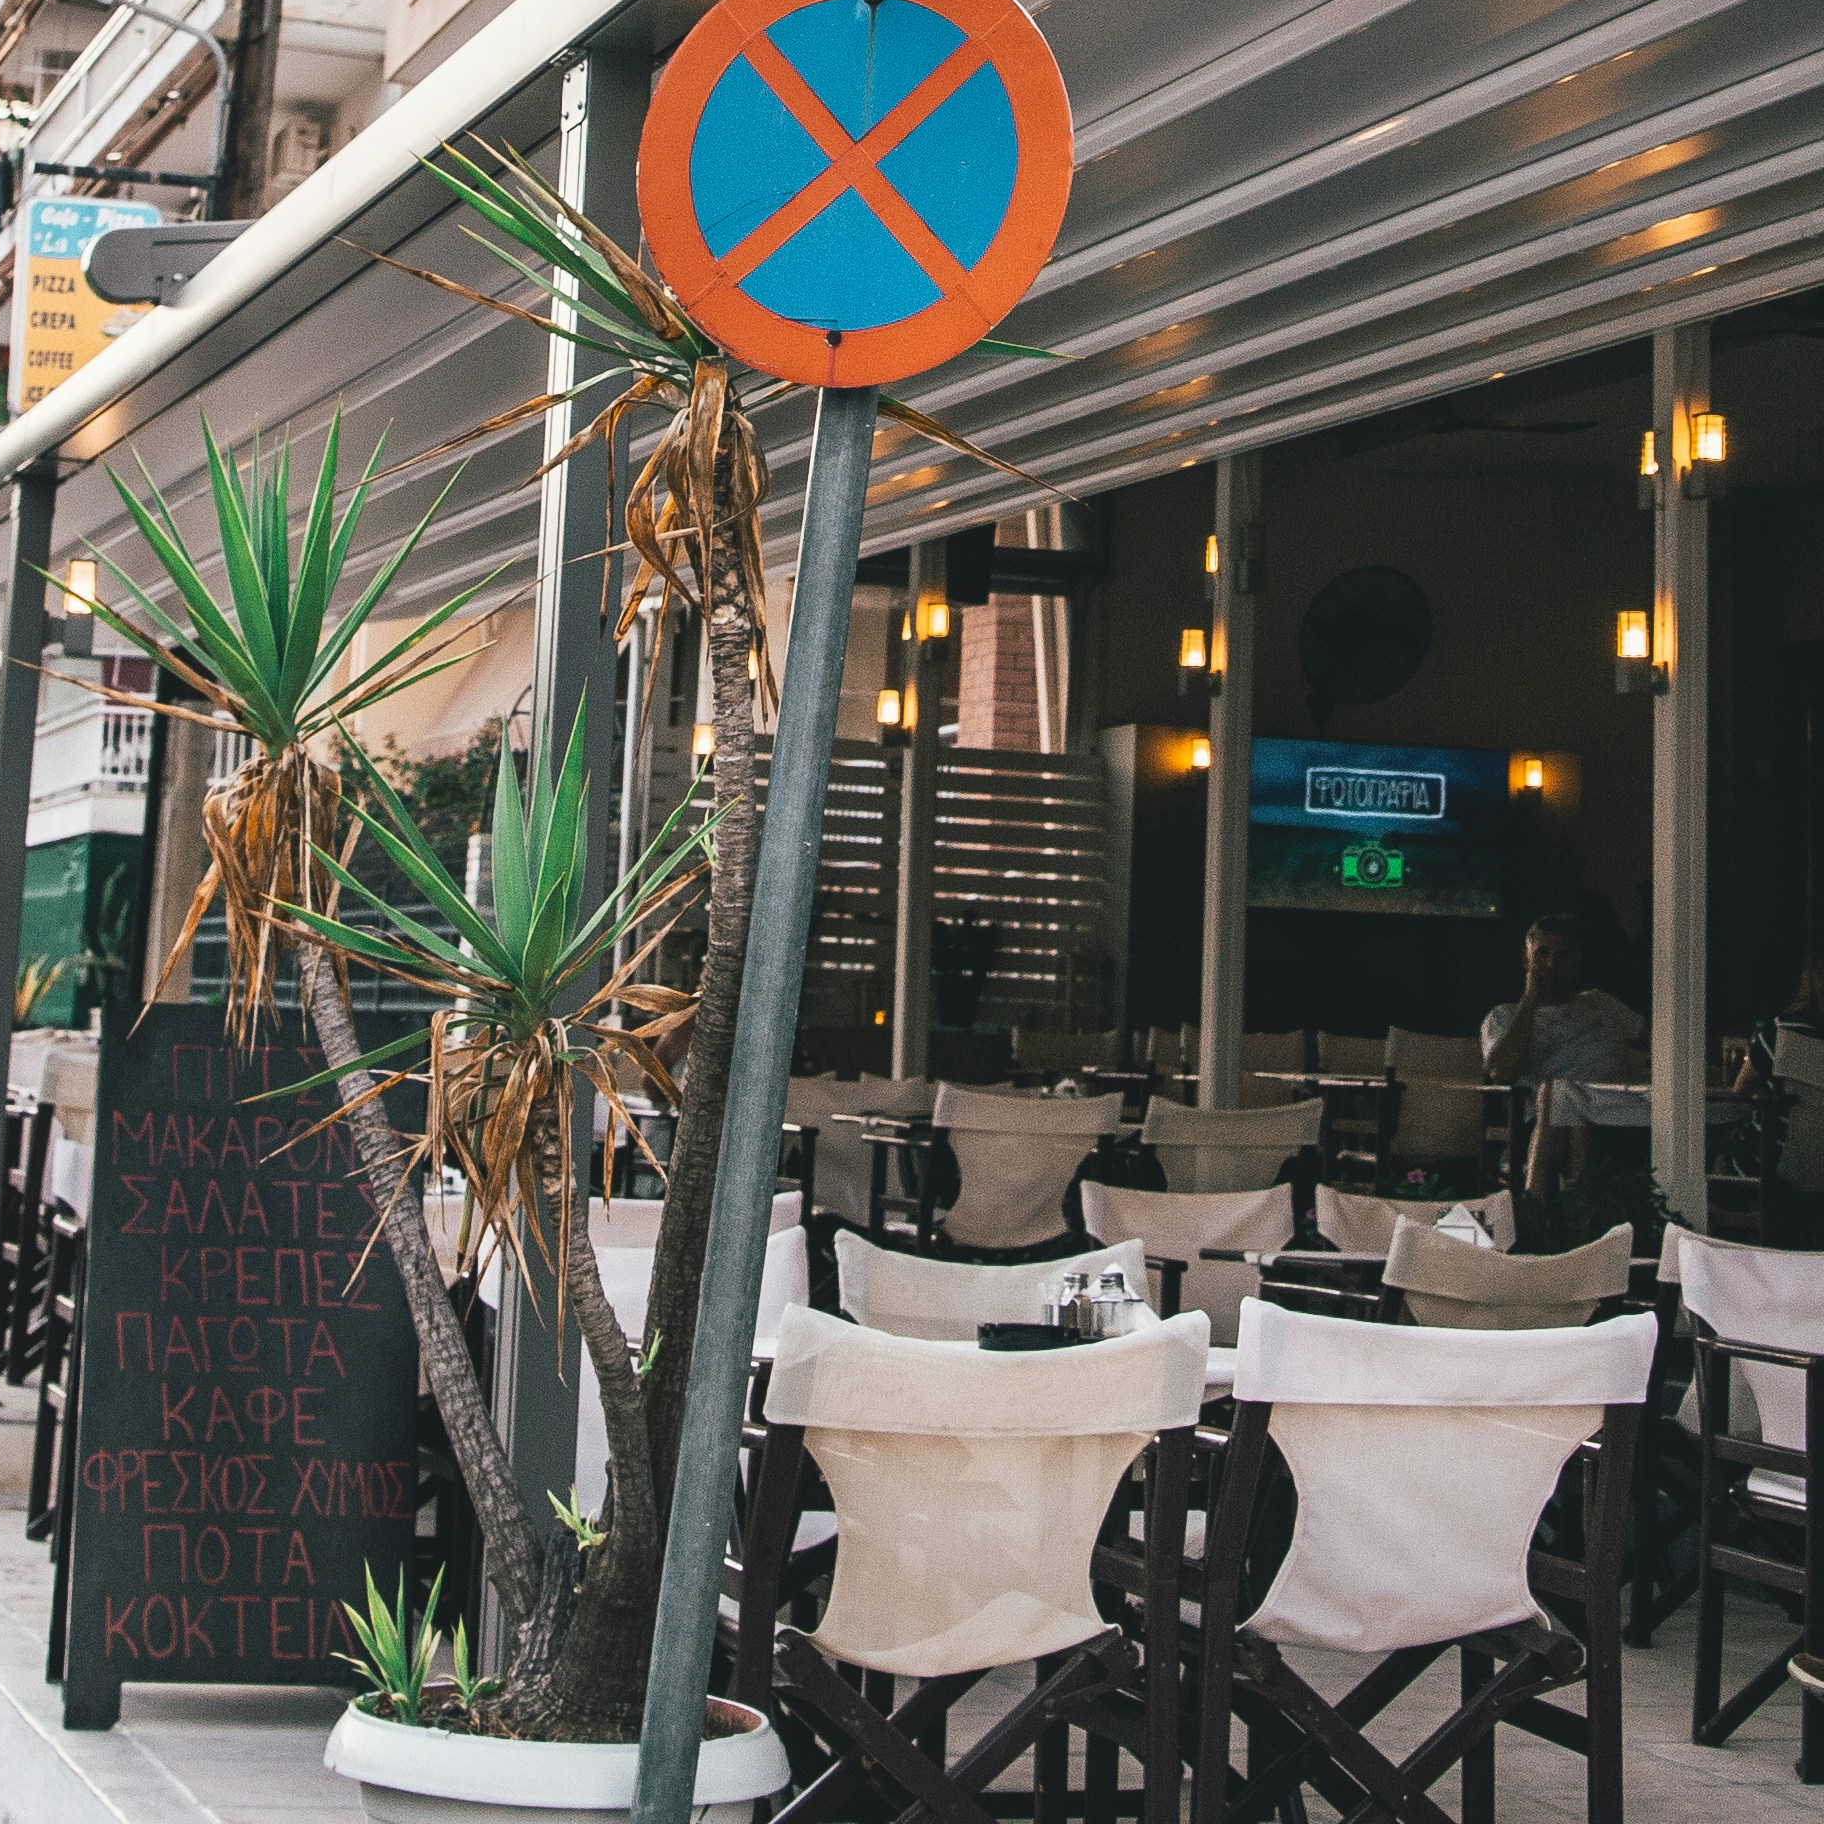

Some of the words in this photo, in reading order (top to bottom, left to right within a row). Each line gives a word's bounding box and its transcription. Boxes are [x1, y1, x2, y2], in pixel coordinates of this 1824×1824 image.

[32, 273, 76, 294] PIZZA
[30, 311, 76, 330] CREPA
[28, 349, 73, 370] COFFEE
[120, 1174, 387, 1242] ΣΑΛΑΤΕΣ
[159, 1243, 382, 1311] ΚΡΕΠΕΣ
[161, 1382, 327, 1446] ΚΑΦΕ
[82, 1446, 277, 1516] ΦΡΕΣΚΟΣ
[289, 1456, 416, 1521] ΧΥΜΟΣ
[142, 1523, 317, 1586] ΠΟΤΑ
